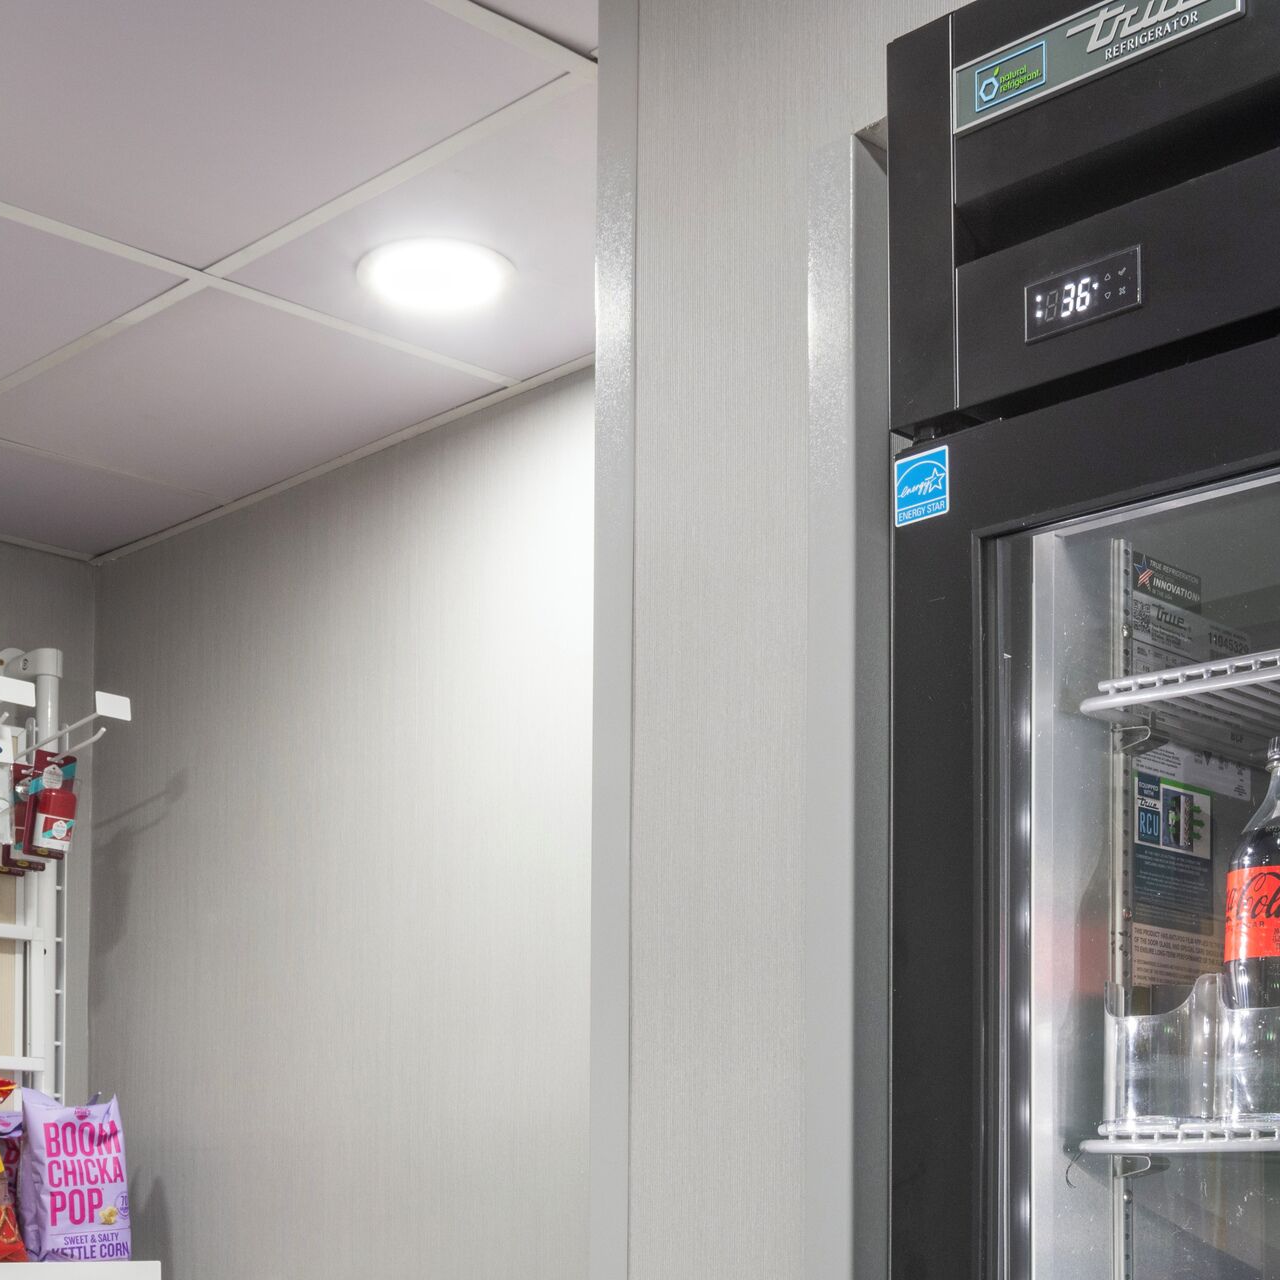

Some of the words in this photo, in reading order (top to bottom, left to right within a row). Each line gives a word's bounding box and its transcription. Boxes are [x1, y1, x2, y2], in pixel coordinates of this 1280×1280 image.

[1105, 10, 1199, 60] REFRIGERATOR
[898, 506, 926, 521] ENERGY
[927, 500, 945, 513] STAR
[1139, 810, 1159, 836] RCU
[43, 1119, 122, 1158] BOOM
[46, 1154, 125, 1189] CHICKA
[49, 1187, 103, 1227] POP
[63, 1234, 88, 1247] SWEET
[90, 1233, 97, 1244] &
[97, 1232, 119, 1244] SALTY
[99, 1242, 130, 1259] CORN
